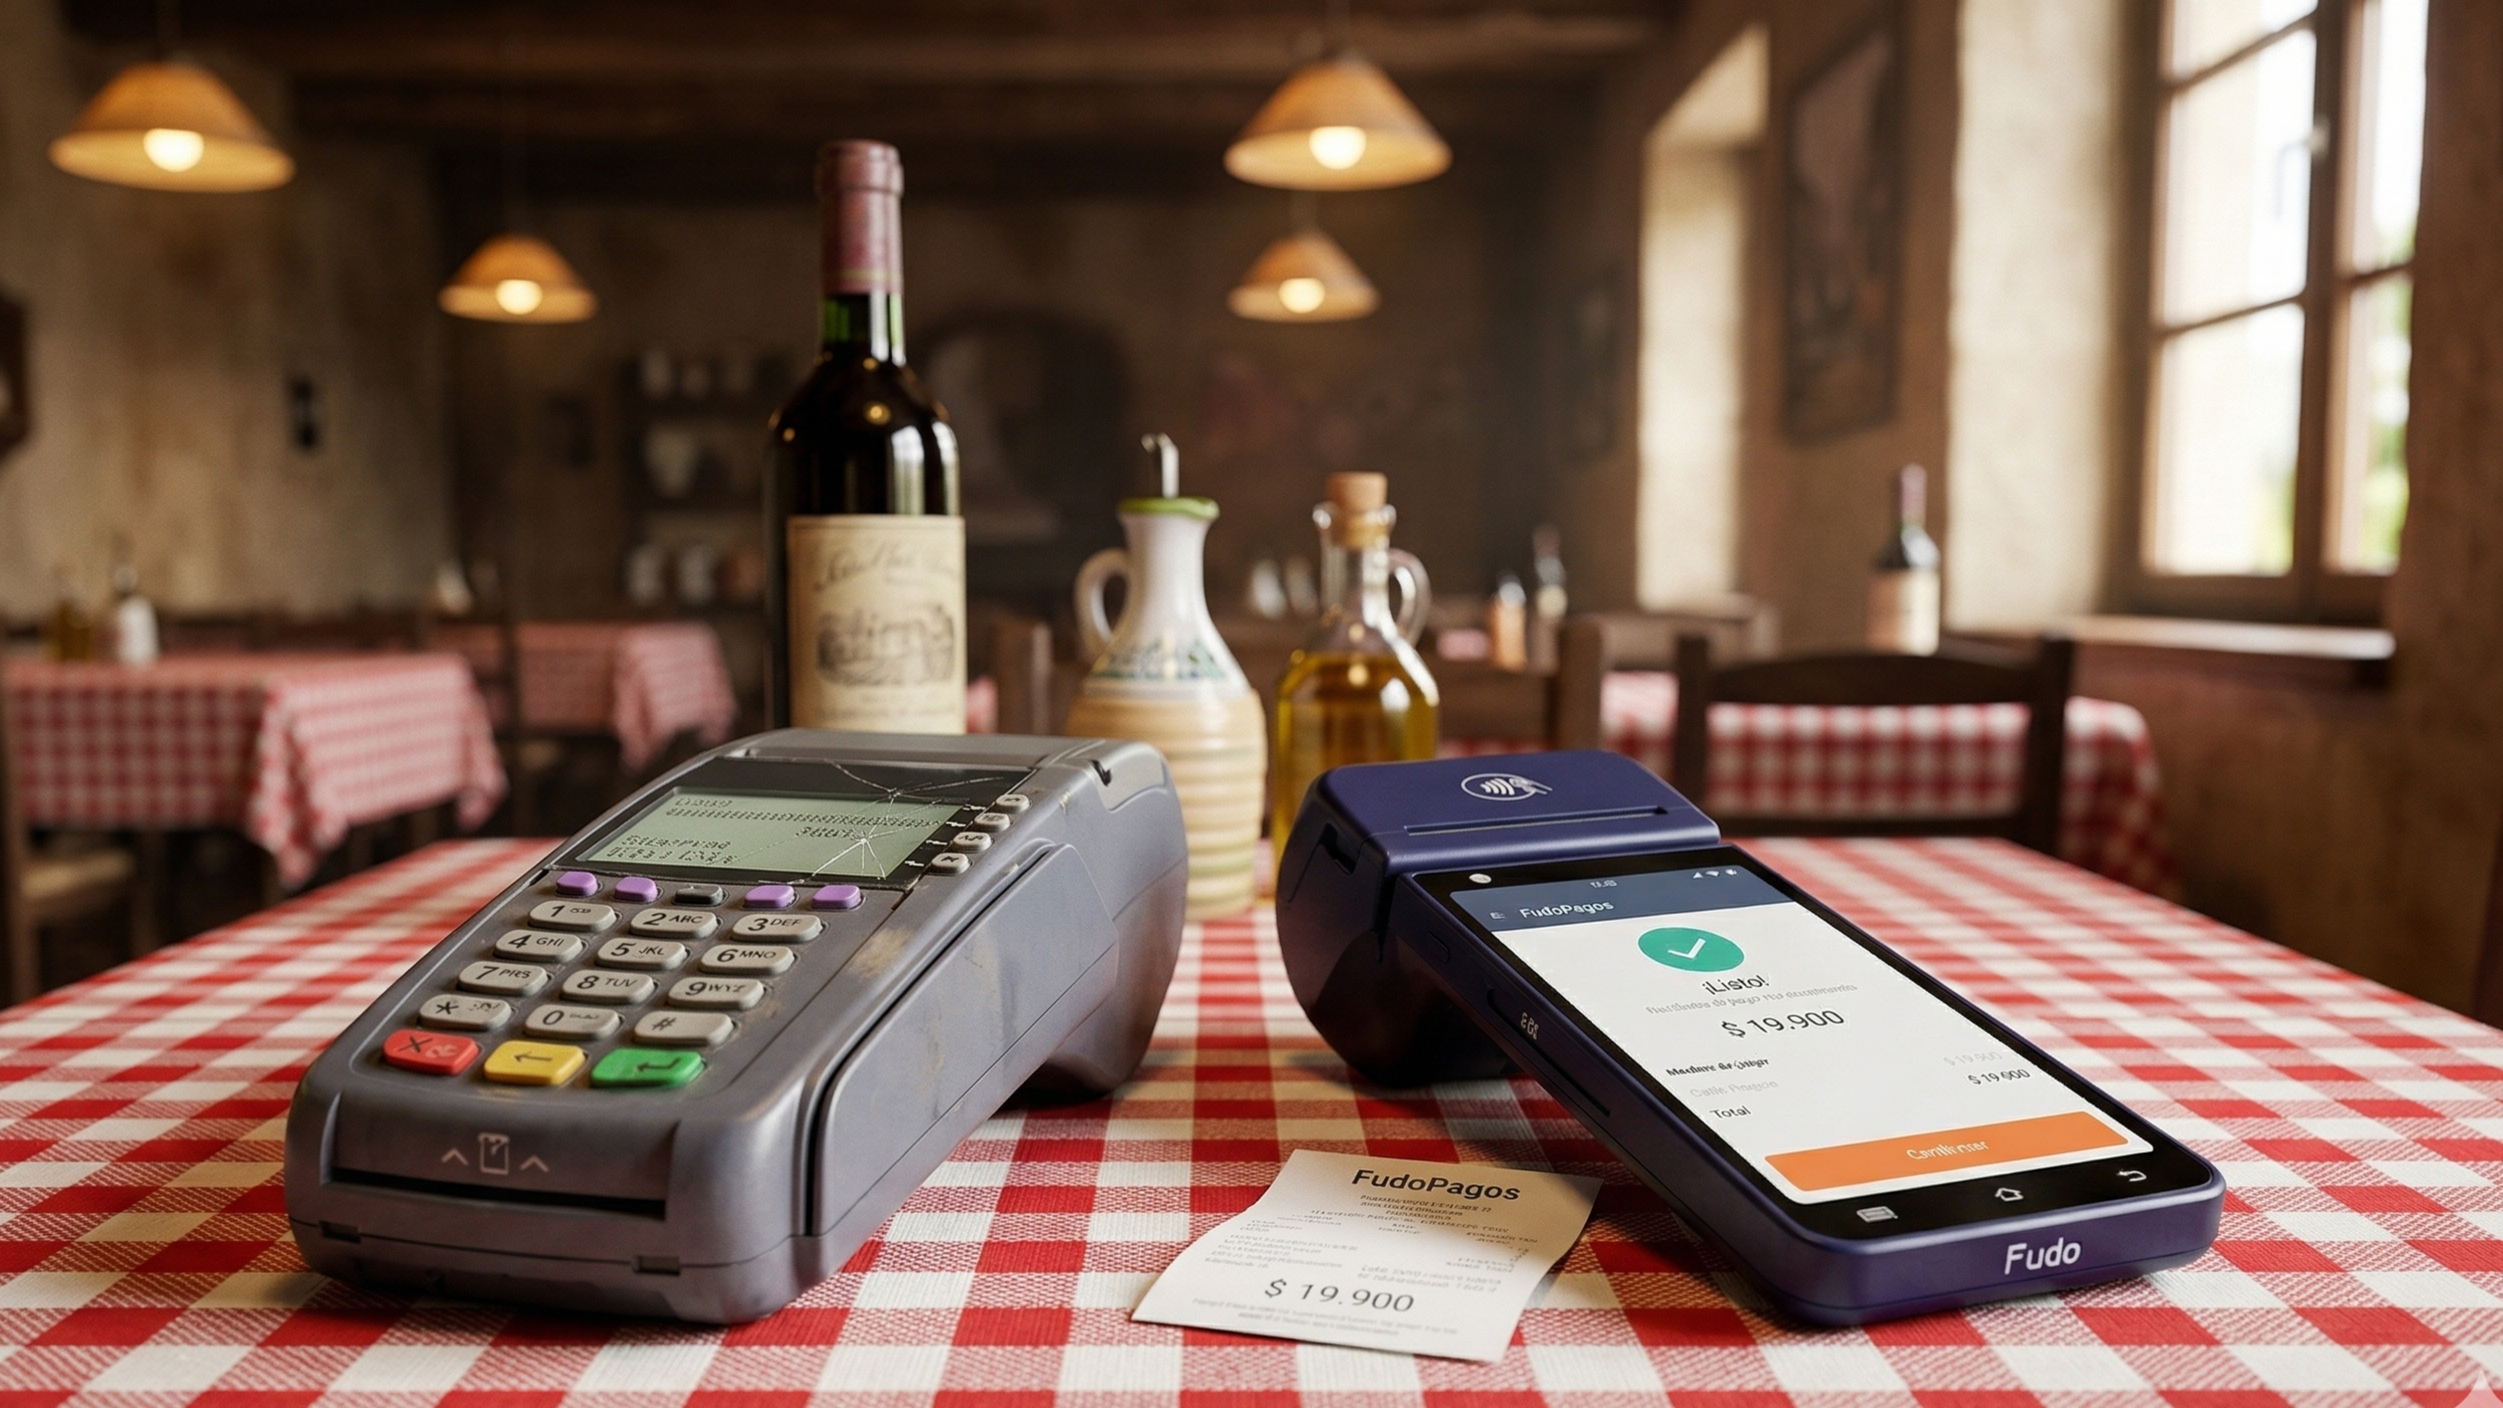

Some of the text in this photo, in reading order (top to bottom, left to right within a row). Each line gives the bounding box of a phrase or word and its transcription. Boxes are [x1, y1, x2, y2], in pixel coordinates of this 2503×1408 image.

[551, 904, 566, 918] 1
[1519, 902, 1614, 918] FudoPagos
[643, 912, 667, 926] 2
[748, 917, 802, 931] 3 DEF
[508, 934, 532, 949] 4
[610, 942, 665, 957] 5 JKL
[717, 948, 777, 962] 6 MNO
[476, 965, 532, 980] 7 PRS
[577, 975, 638, 989] 8 TUV
[685, 981, 707, 996] 9
[1702, 974, 1769, 996] ¡Listo!
[542, 1009, 565, 1026] 0
[1721, 1009, 1845, 1038] $ 19.900
[1709, 1105, 1751, 1119] Total
[1352, 1169, 1521, 1201] FudoPagos
[2004, 1236, 2081, 1276] Fudo
[1264, 1278, 1415, 1313] $ 19.900
